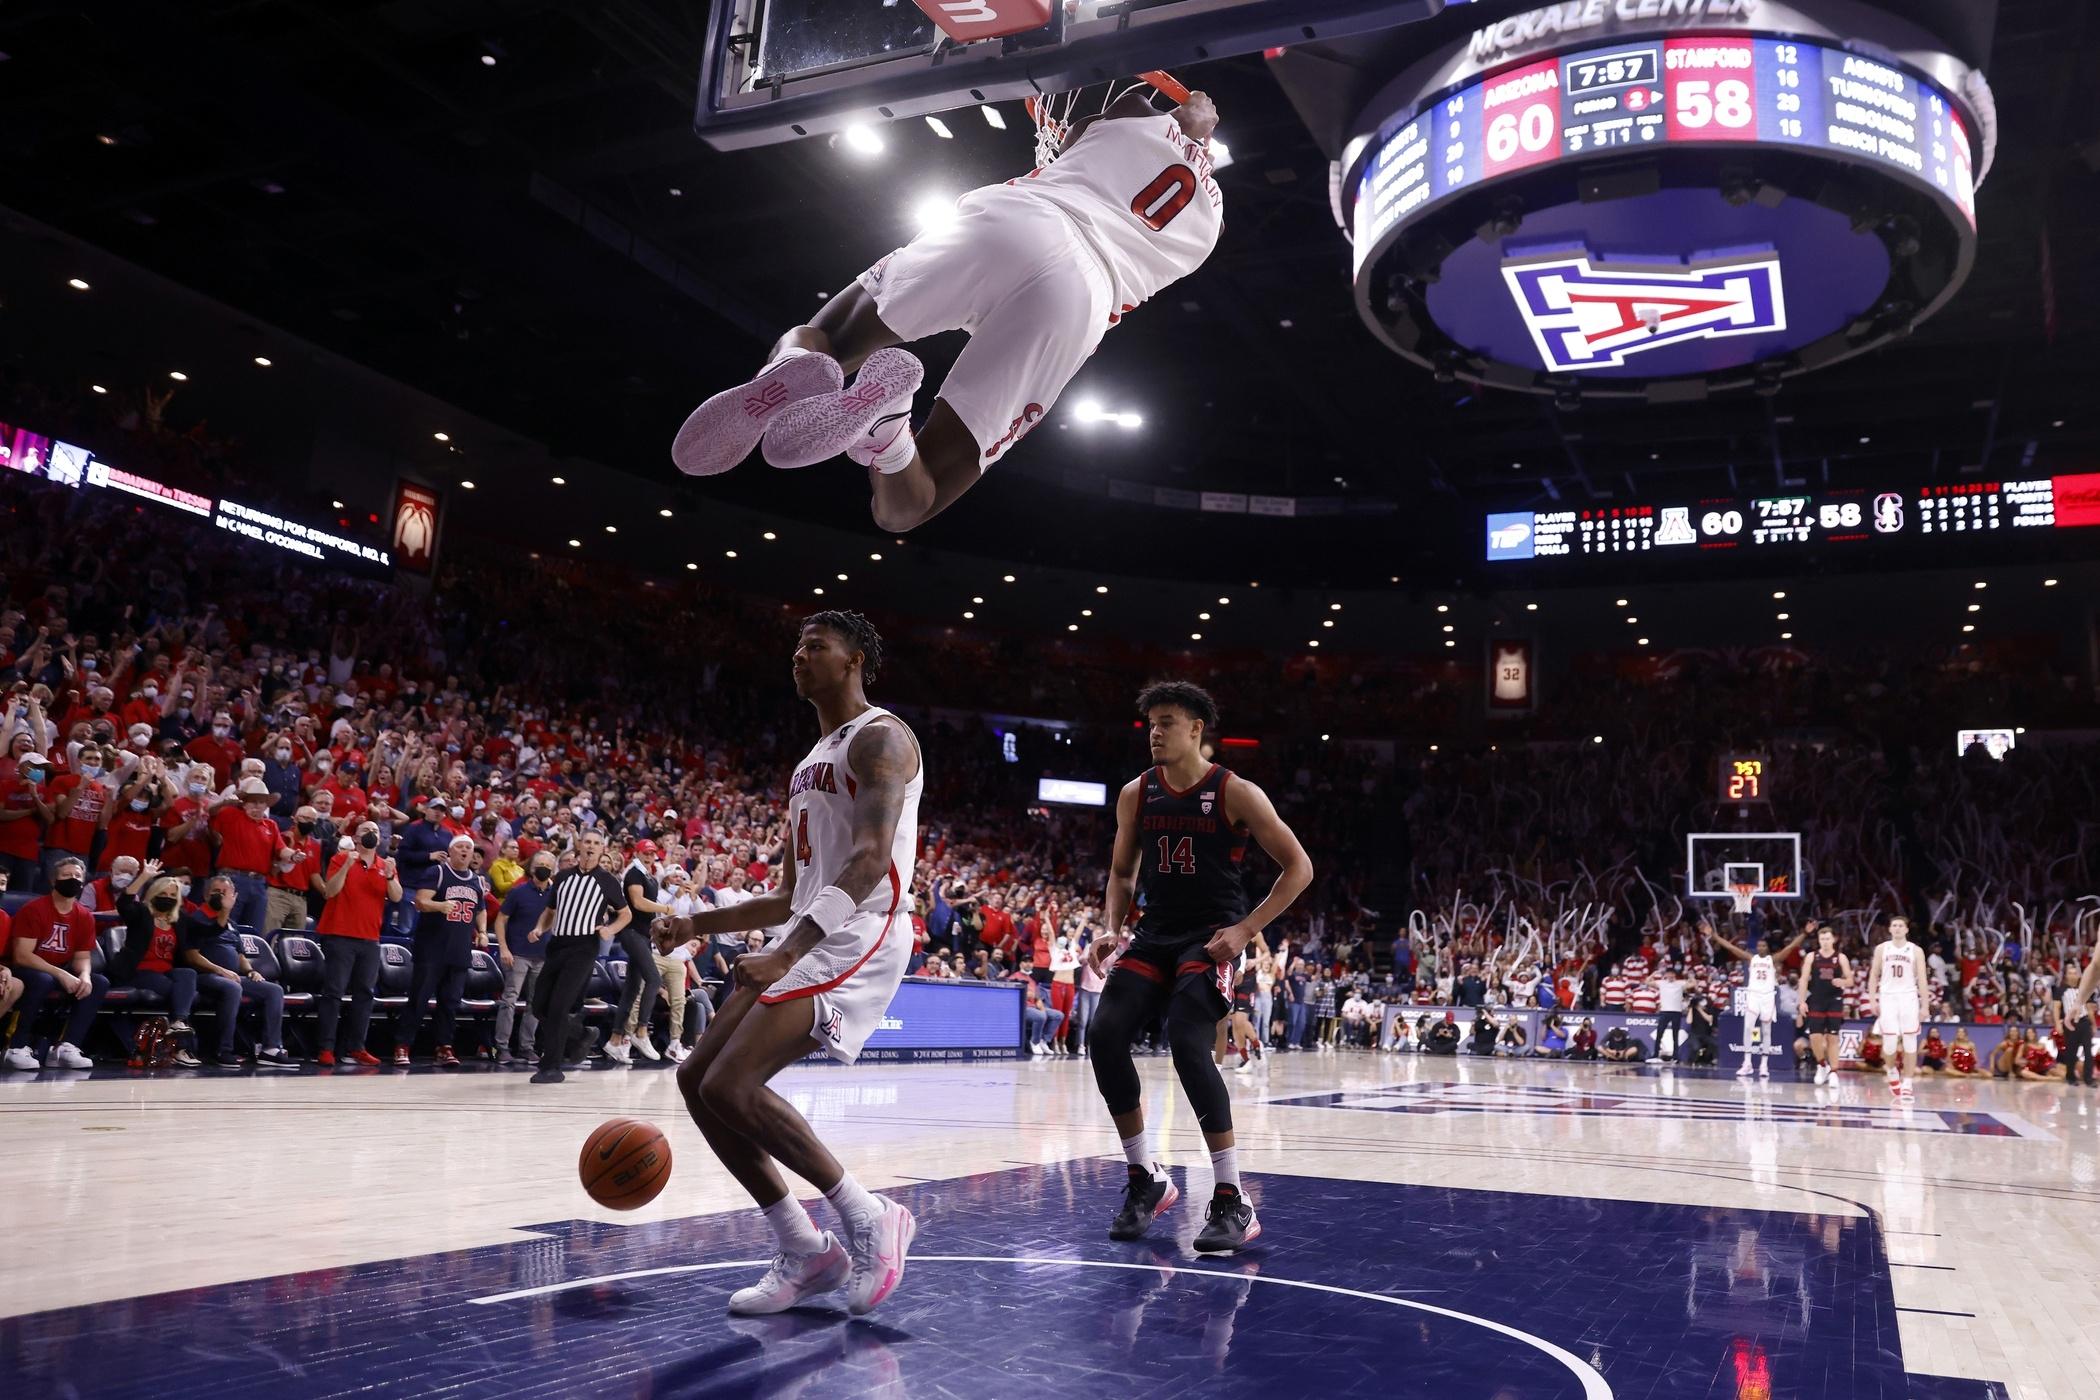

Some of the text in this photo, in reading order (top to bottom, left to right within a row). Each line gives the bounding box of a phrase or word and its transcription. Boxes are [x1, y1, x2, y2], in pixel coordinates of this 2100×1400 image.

[1467, 0, 1605, 55] MCKALE
[1665, 47, 1752, 69] STANFORD
[1775, 45, 1797, 64] 12
[1578, 57, 1643, 86] 7:57
[1843, 56, 1904, 92] ASSISTS
[1483, 69, 1559, 109] ARIZONA
[1629, 91, 1643, 108] 2
[1829, 76, 1916, 121] TURNOVERS
[1676, 79, 1752, 128] 58
[1487, 103, 1554, 162] 60
[1835, 101, 1914, 143] REBOUNDS
[1828, 124, 1877, 153] BENCH
[1878, 138, 1923, 171] POINTS
[1166, 123, 1221, 208] MTHURIN
[1130, 164, 1197, 232] 0
[2003, 480, 2053, 492] PLAYER
[2006, 491, 2054, 504] POINTS
[219, 499, 284, 530] RETURNING
[283, 520, 308, 539] FOR
[1534, 512, 1576, 524] PLAYER
[1758, 499, 1805, 517] 7:57
[1819, 503, 1862, 528] 58
[215, 515, 265, 541] MICHAEL
[1534, 522, 1574, 534] POINTS
[1702, 511, 1743, 535] 60
[1503, 667, 1520, 680] 32
[1729, 775, 1758, 798] 27
[1143, 815, 1217, 833] STANFORD
[796, 808, 811, 867] 4
[1158, 835, 1195, 874] 14
[447, 900, 475, 924] 25
[39, 923, 70, 952] A
[1891, 964, 1904, 978] 10
